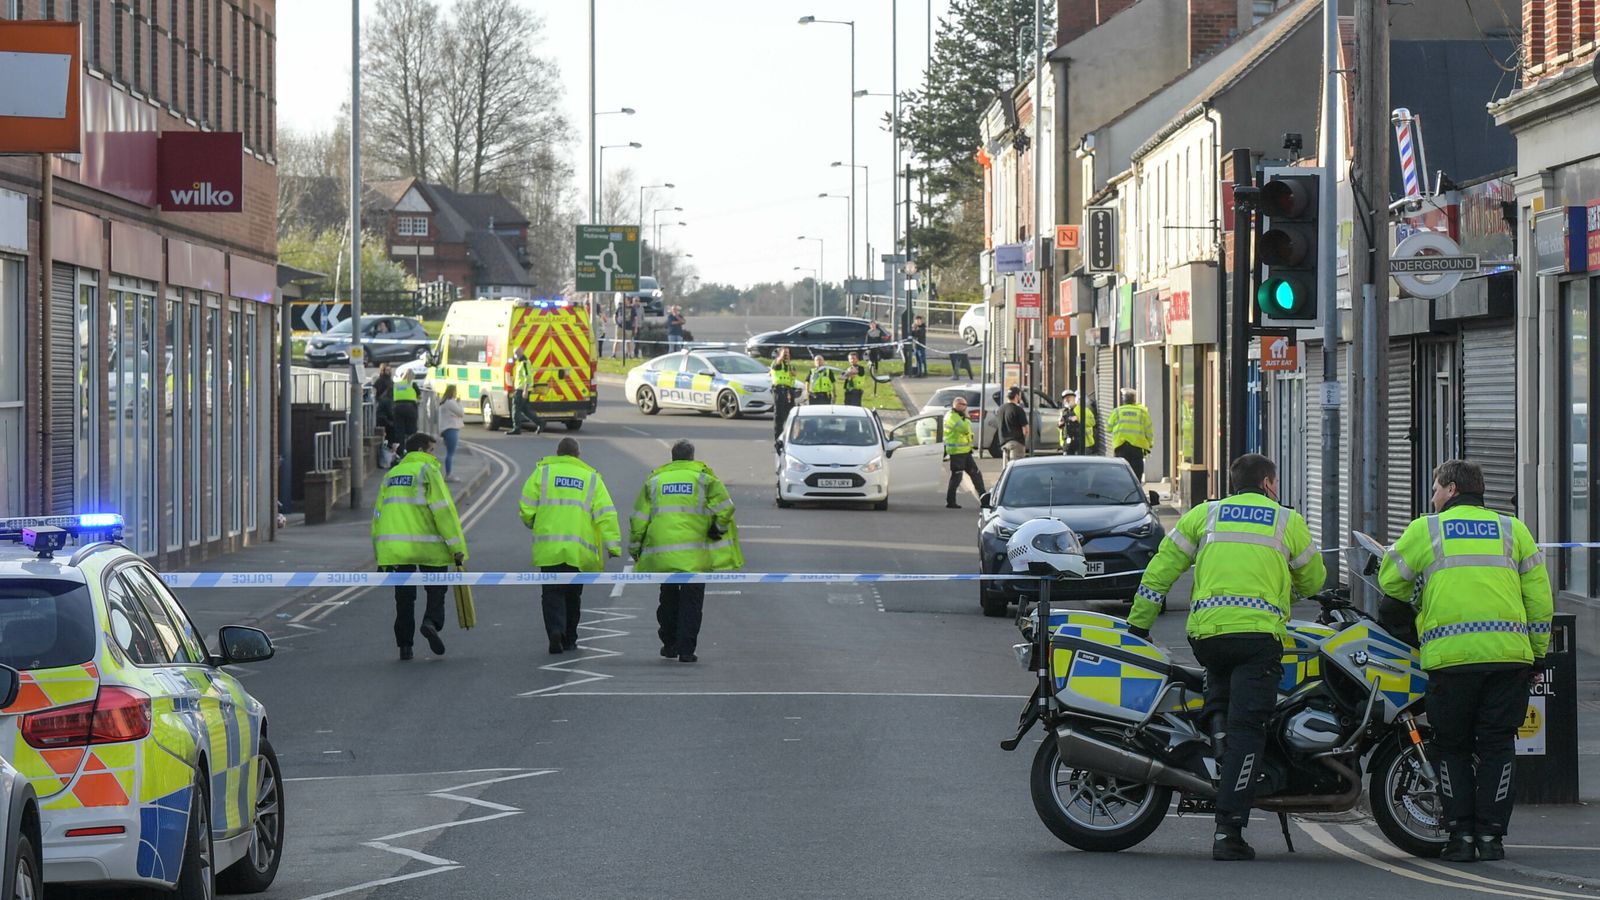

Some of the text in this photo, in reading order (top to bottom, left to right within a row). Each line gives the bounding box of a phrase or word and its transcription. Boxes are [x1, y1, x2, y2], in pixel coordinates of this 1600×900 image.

[170, 182, 234, 205] wilko
[1389, 258, 1475, 272] NDERGROUND
[1265, 359, 1280, 367] JUST
[660, 389, 713, 405] POLICE
[556, 477, 583, 489] POLICE
[663, 484, 692, 494] POLICE
[1220, 506, 1273, 523] POLICE
[1445, 522, 1498, 536] POLICE
